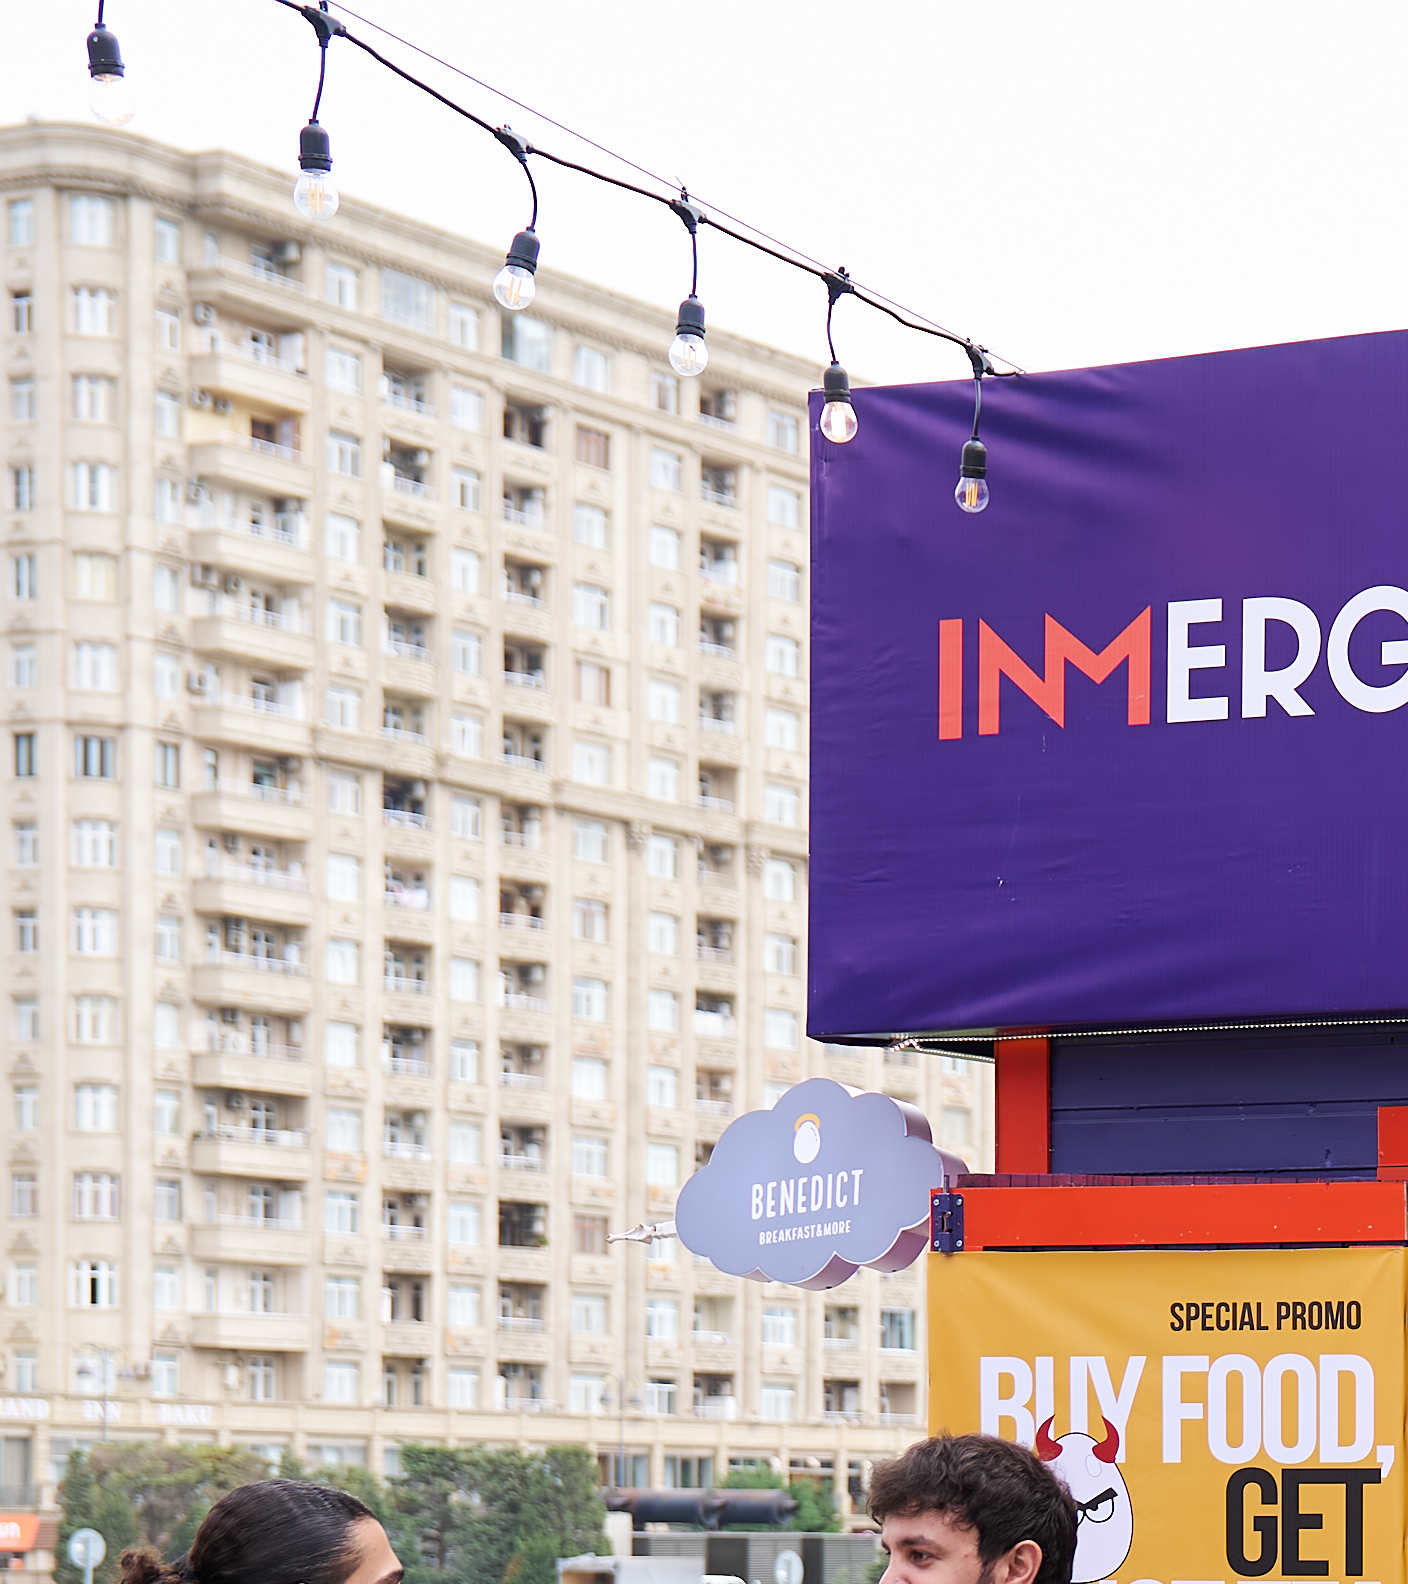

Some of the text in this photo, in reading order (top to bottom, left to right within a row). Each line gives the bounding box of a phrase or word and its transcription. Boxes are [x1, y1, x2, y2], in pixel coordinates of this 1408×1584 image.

[751, 1169, 863, 1220] BENEDICT
[759, 1220, 851, 1246] BREAKFAST&MORE
[1169, 1301, 1362, 1332] SPECIAL PROMO
[0, 1398, 49, 1420] AND
[1162, 1353, 1396, 1479] FOOD,
[1225, 1467, 1382, 1578] GET
